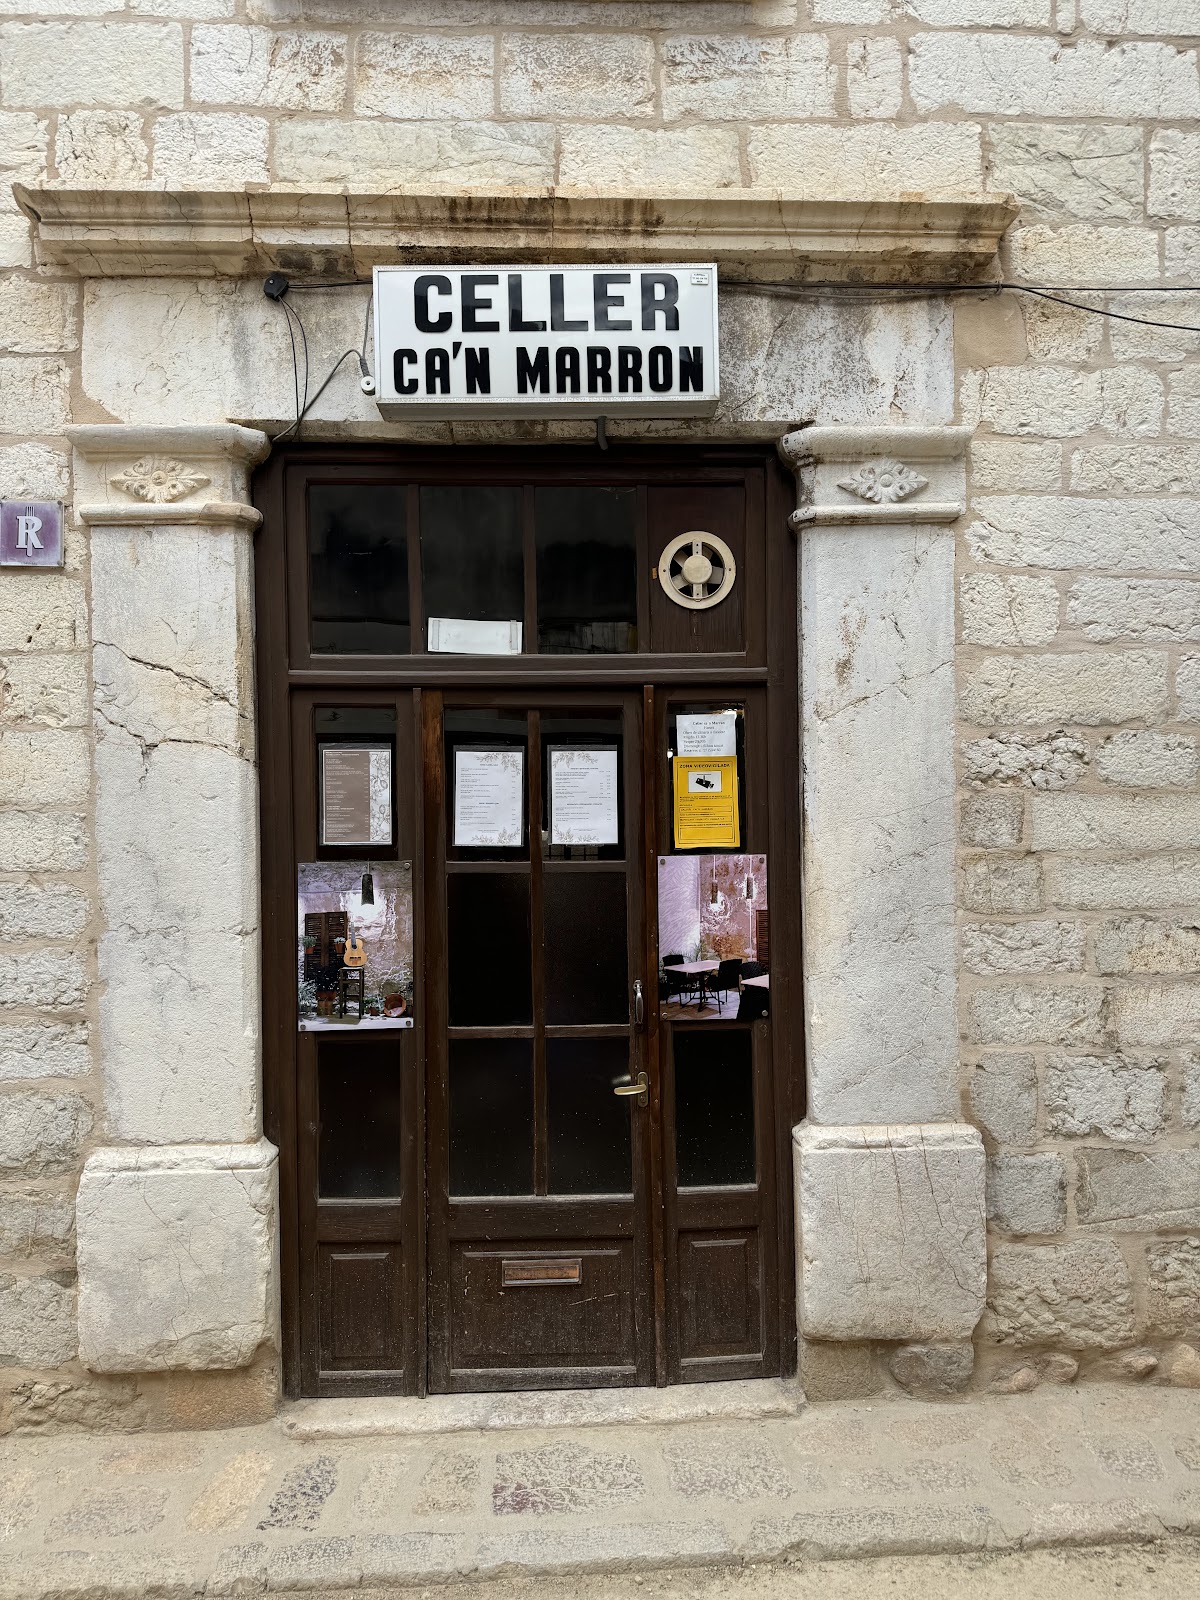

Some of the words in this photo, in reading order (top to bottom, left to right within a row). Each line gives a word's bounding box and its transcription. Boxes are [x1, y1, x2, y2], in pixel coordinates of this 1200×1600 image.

[413, 273, 680, 332] CELLER
[393, 341, 491, 395] CA'N
[516, 345, 704, 394] MARRON
